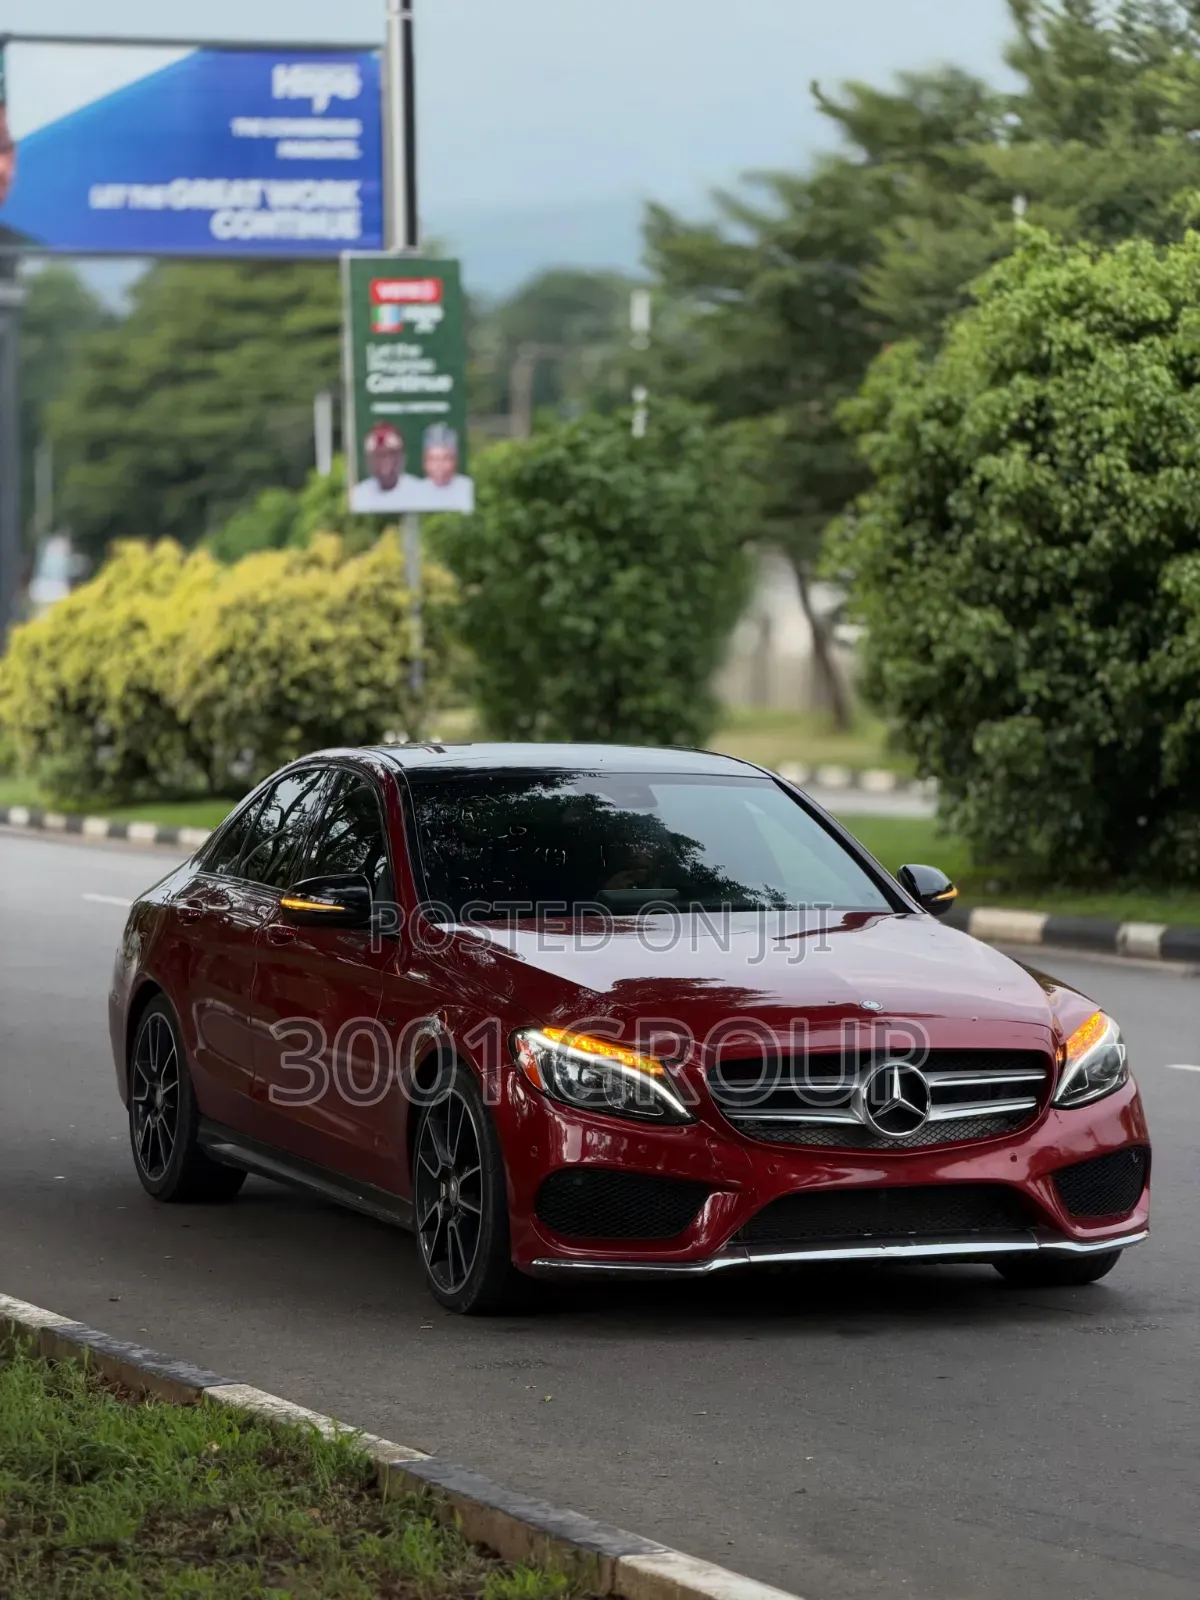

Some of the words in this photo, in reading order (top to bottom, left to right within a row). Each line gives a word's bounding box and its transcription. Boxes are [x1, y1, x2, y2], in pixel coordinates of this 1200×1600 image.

[168, 178, 262, 210] GREAT
[262, 178, 361, 210] WORK
[209, 209, 361, 239] CONTINUE
[365, 372, 454, 394] Continue
